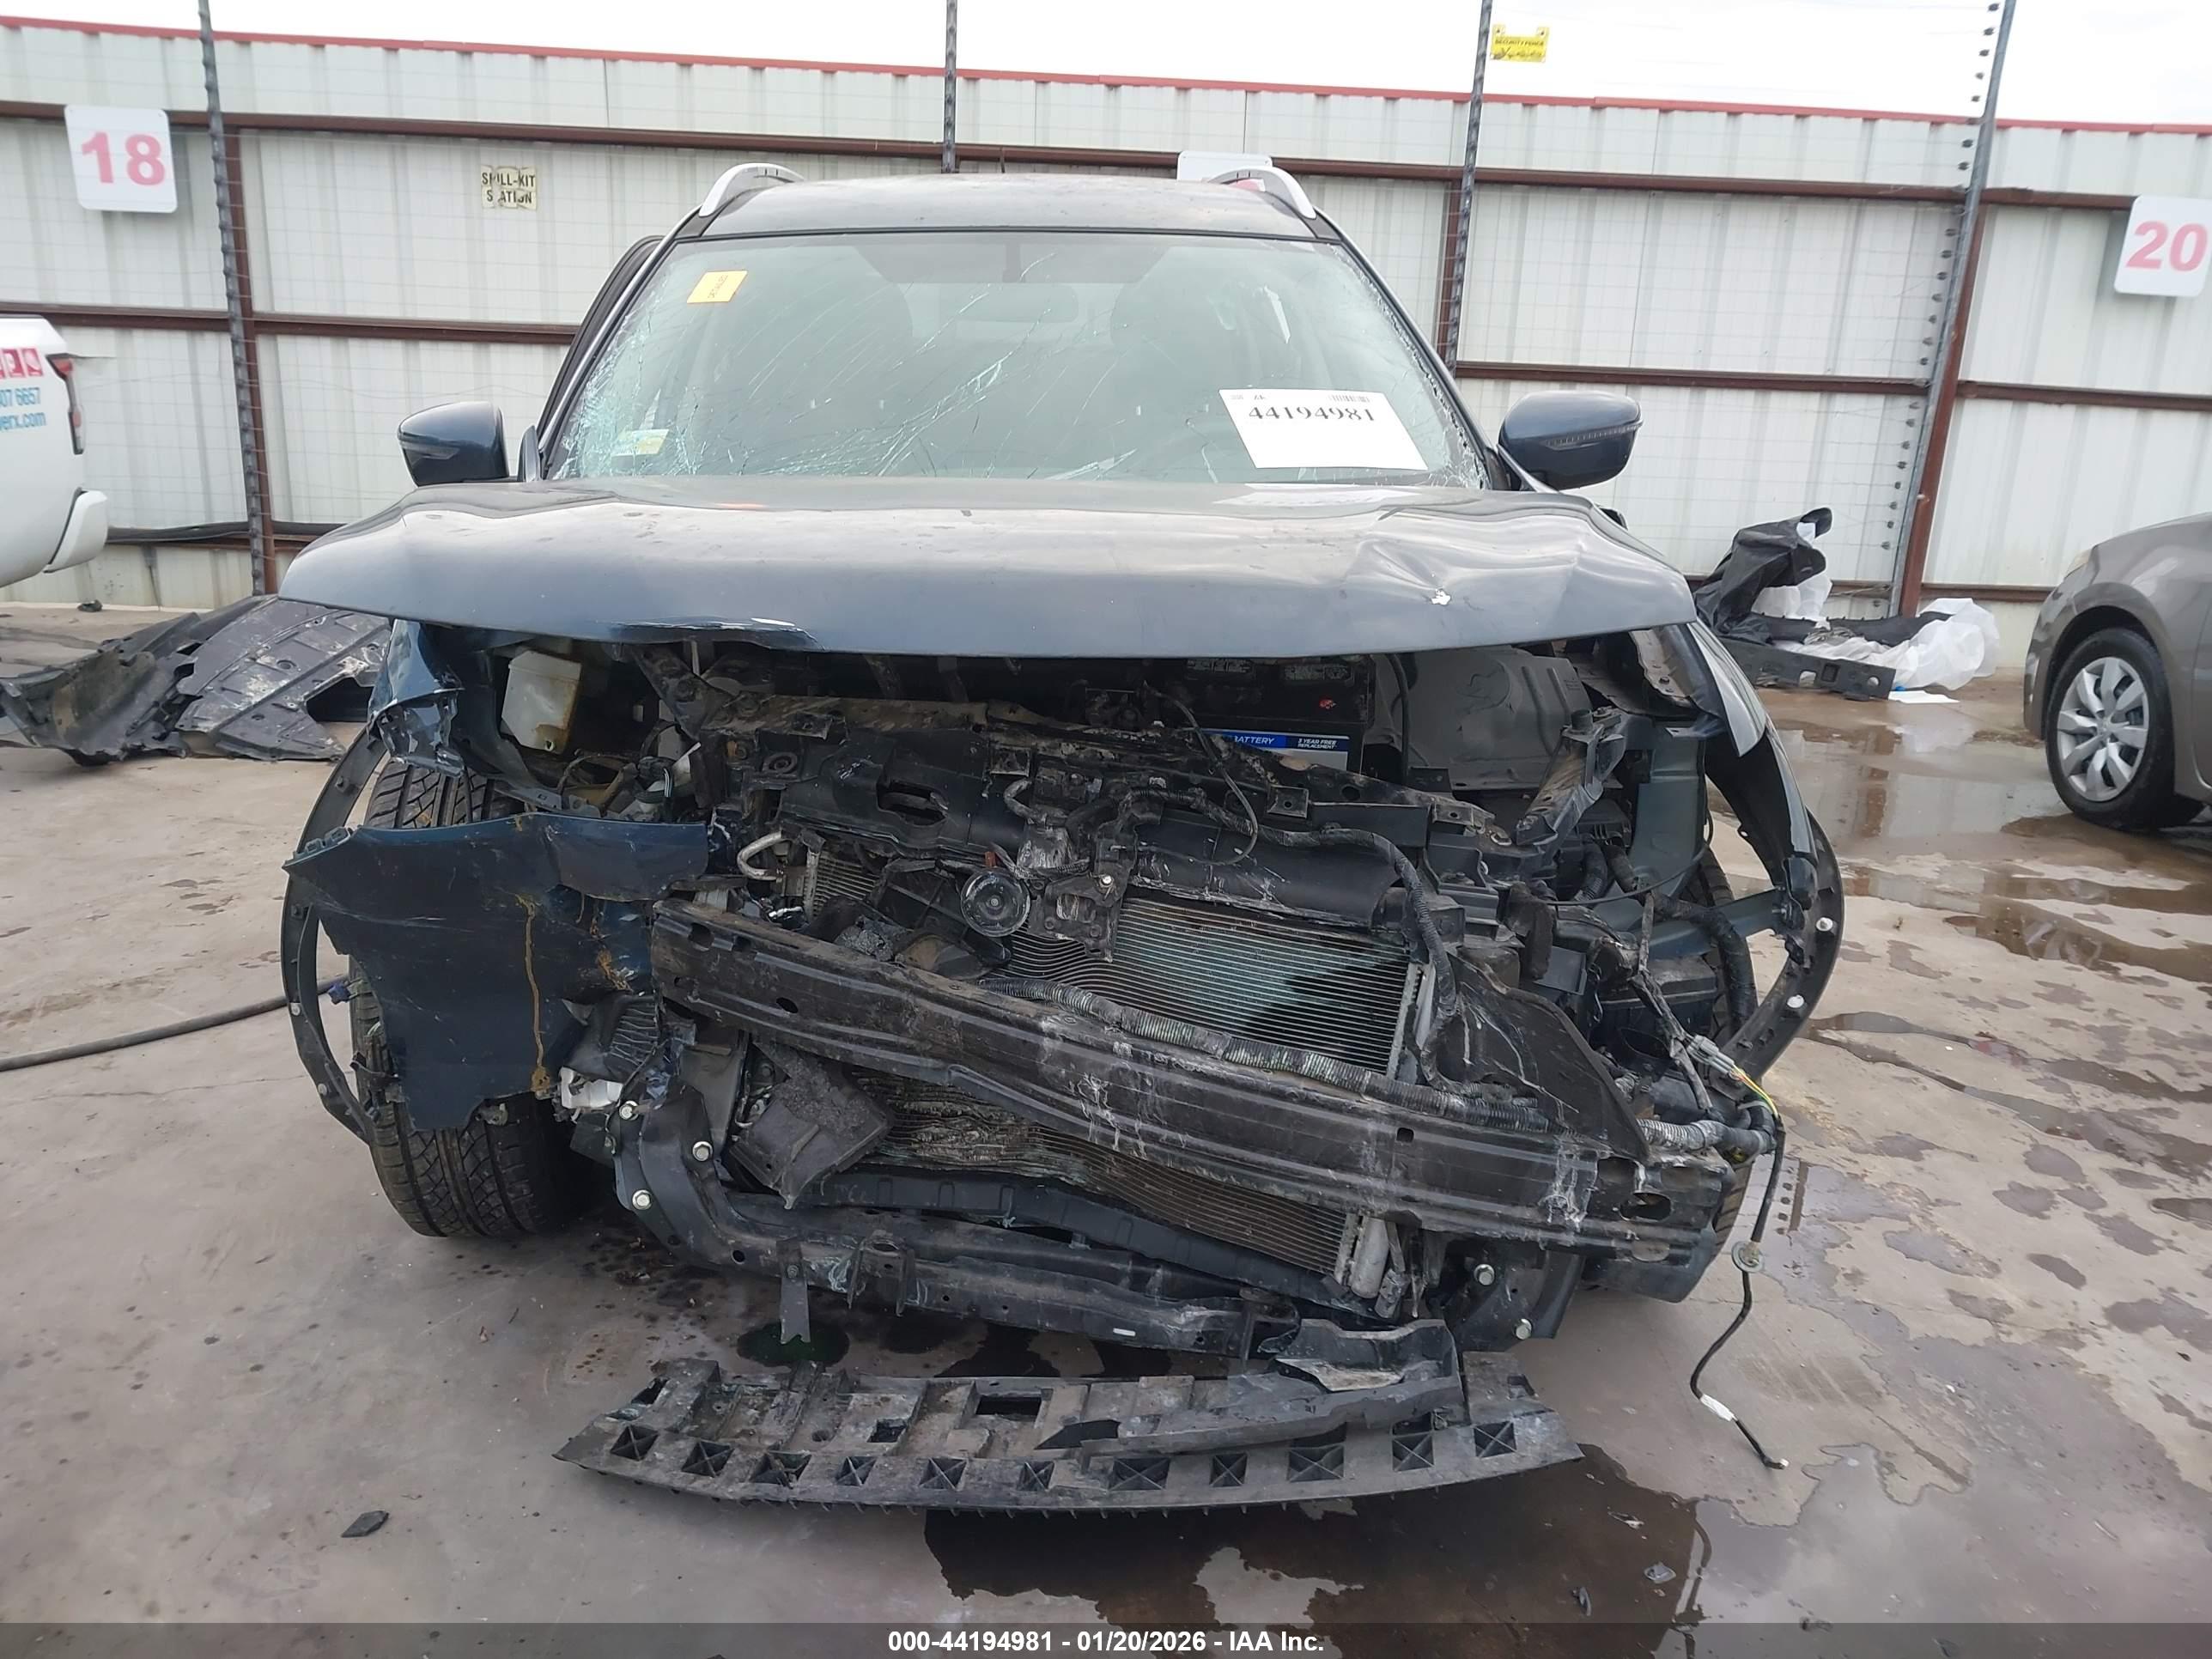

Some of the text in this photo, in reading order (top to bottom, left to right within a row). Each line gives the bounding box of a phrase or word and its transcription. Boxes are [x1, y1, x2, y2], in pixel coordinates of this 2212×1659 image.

[82, 131, 166, 185] 18
[487, 190, 532, 204] SATION
[2125, 221, 2208, 271] 20
[1249, 407, 1374, 421] 44194981
